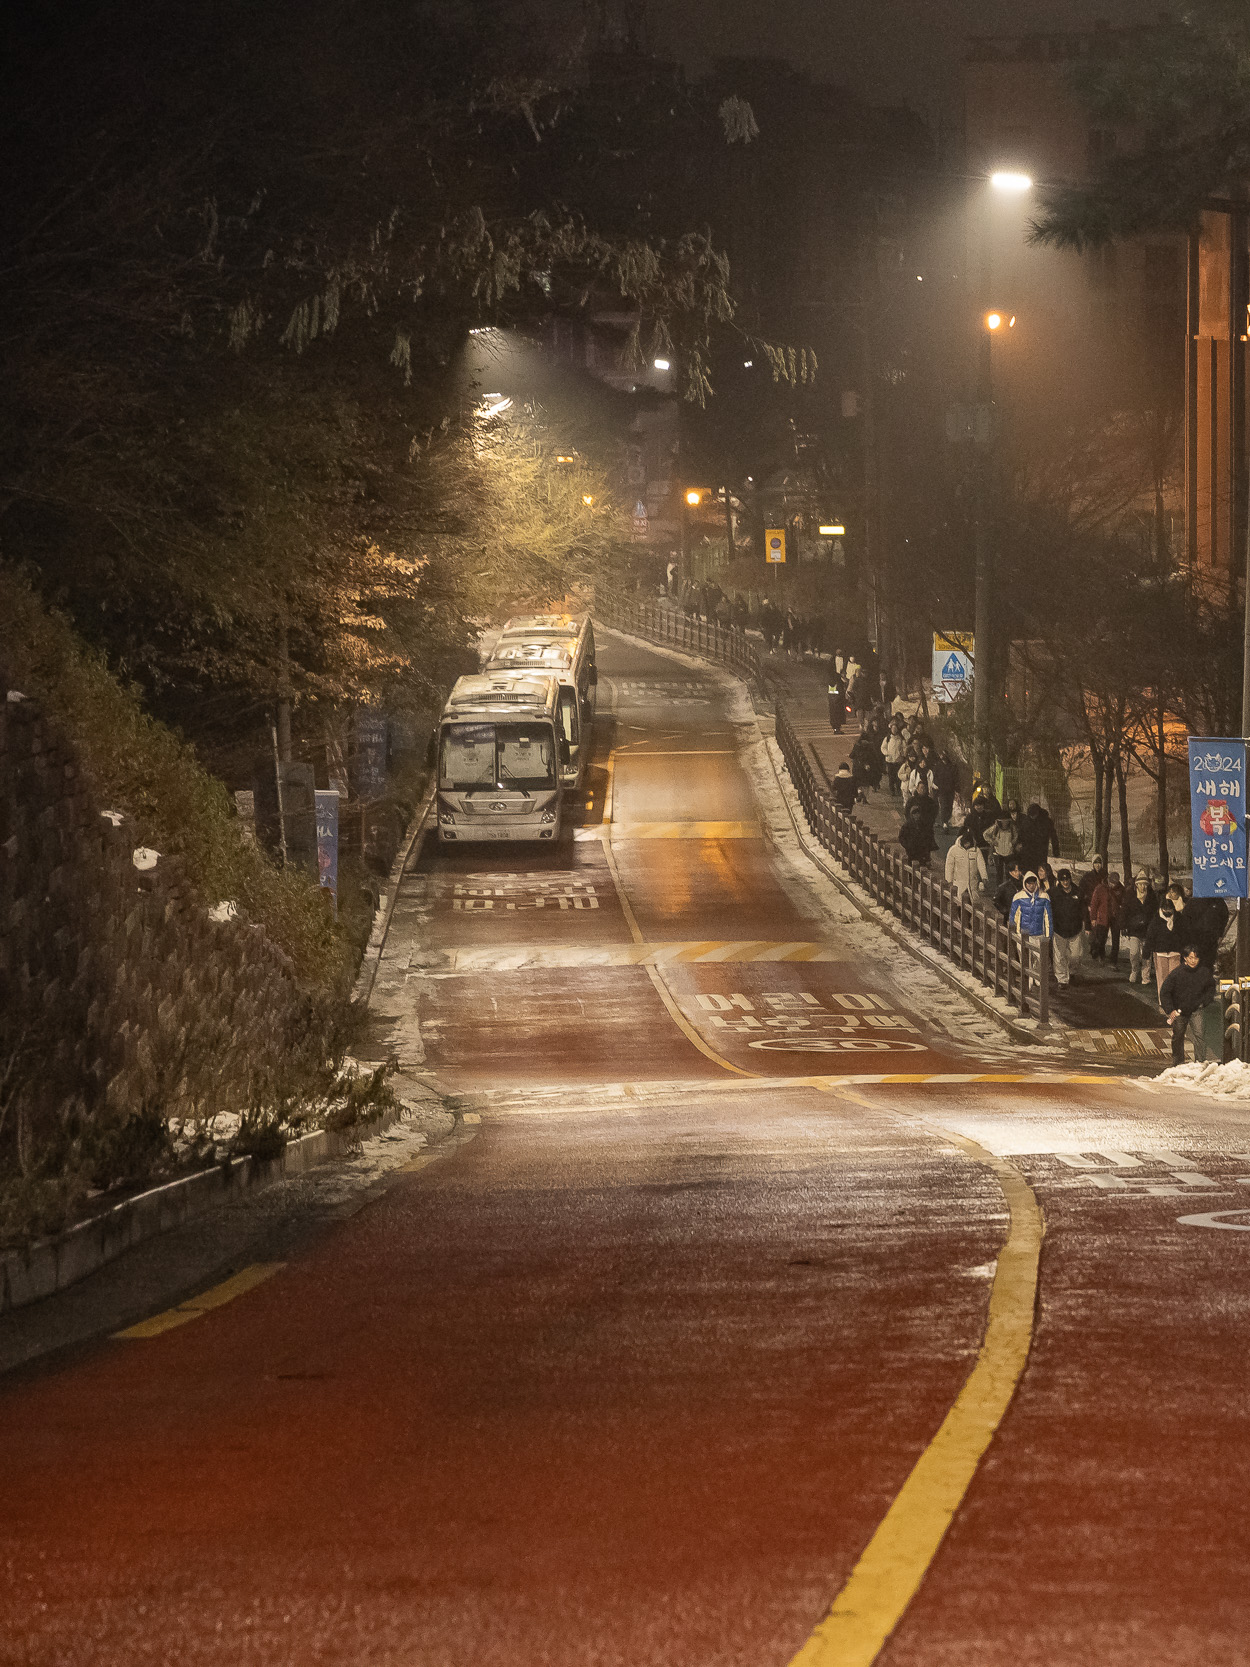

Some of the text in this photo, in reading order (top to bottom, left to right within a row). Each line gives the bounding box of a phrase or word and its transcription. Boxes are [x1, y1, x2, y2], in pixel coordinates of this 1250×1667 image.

[1196, 779, 1240, 798] 새해
[1209, 806, 1226, 835] 복
[1204, 838, 1234, 855] 많이
[1194, 855, 1246, 871] 받으세요
[694, 992, 896, 1012] 어린이
[707, 1013, 923, 1034] 보호구역
[784, 1039, 892, 1050] 30
